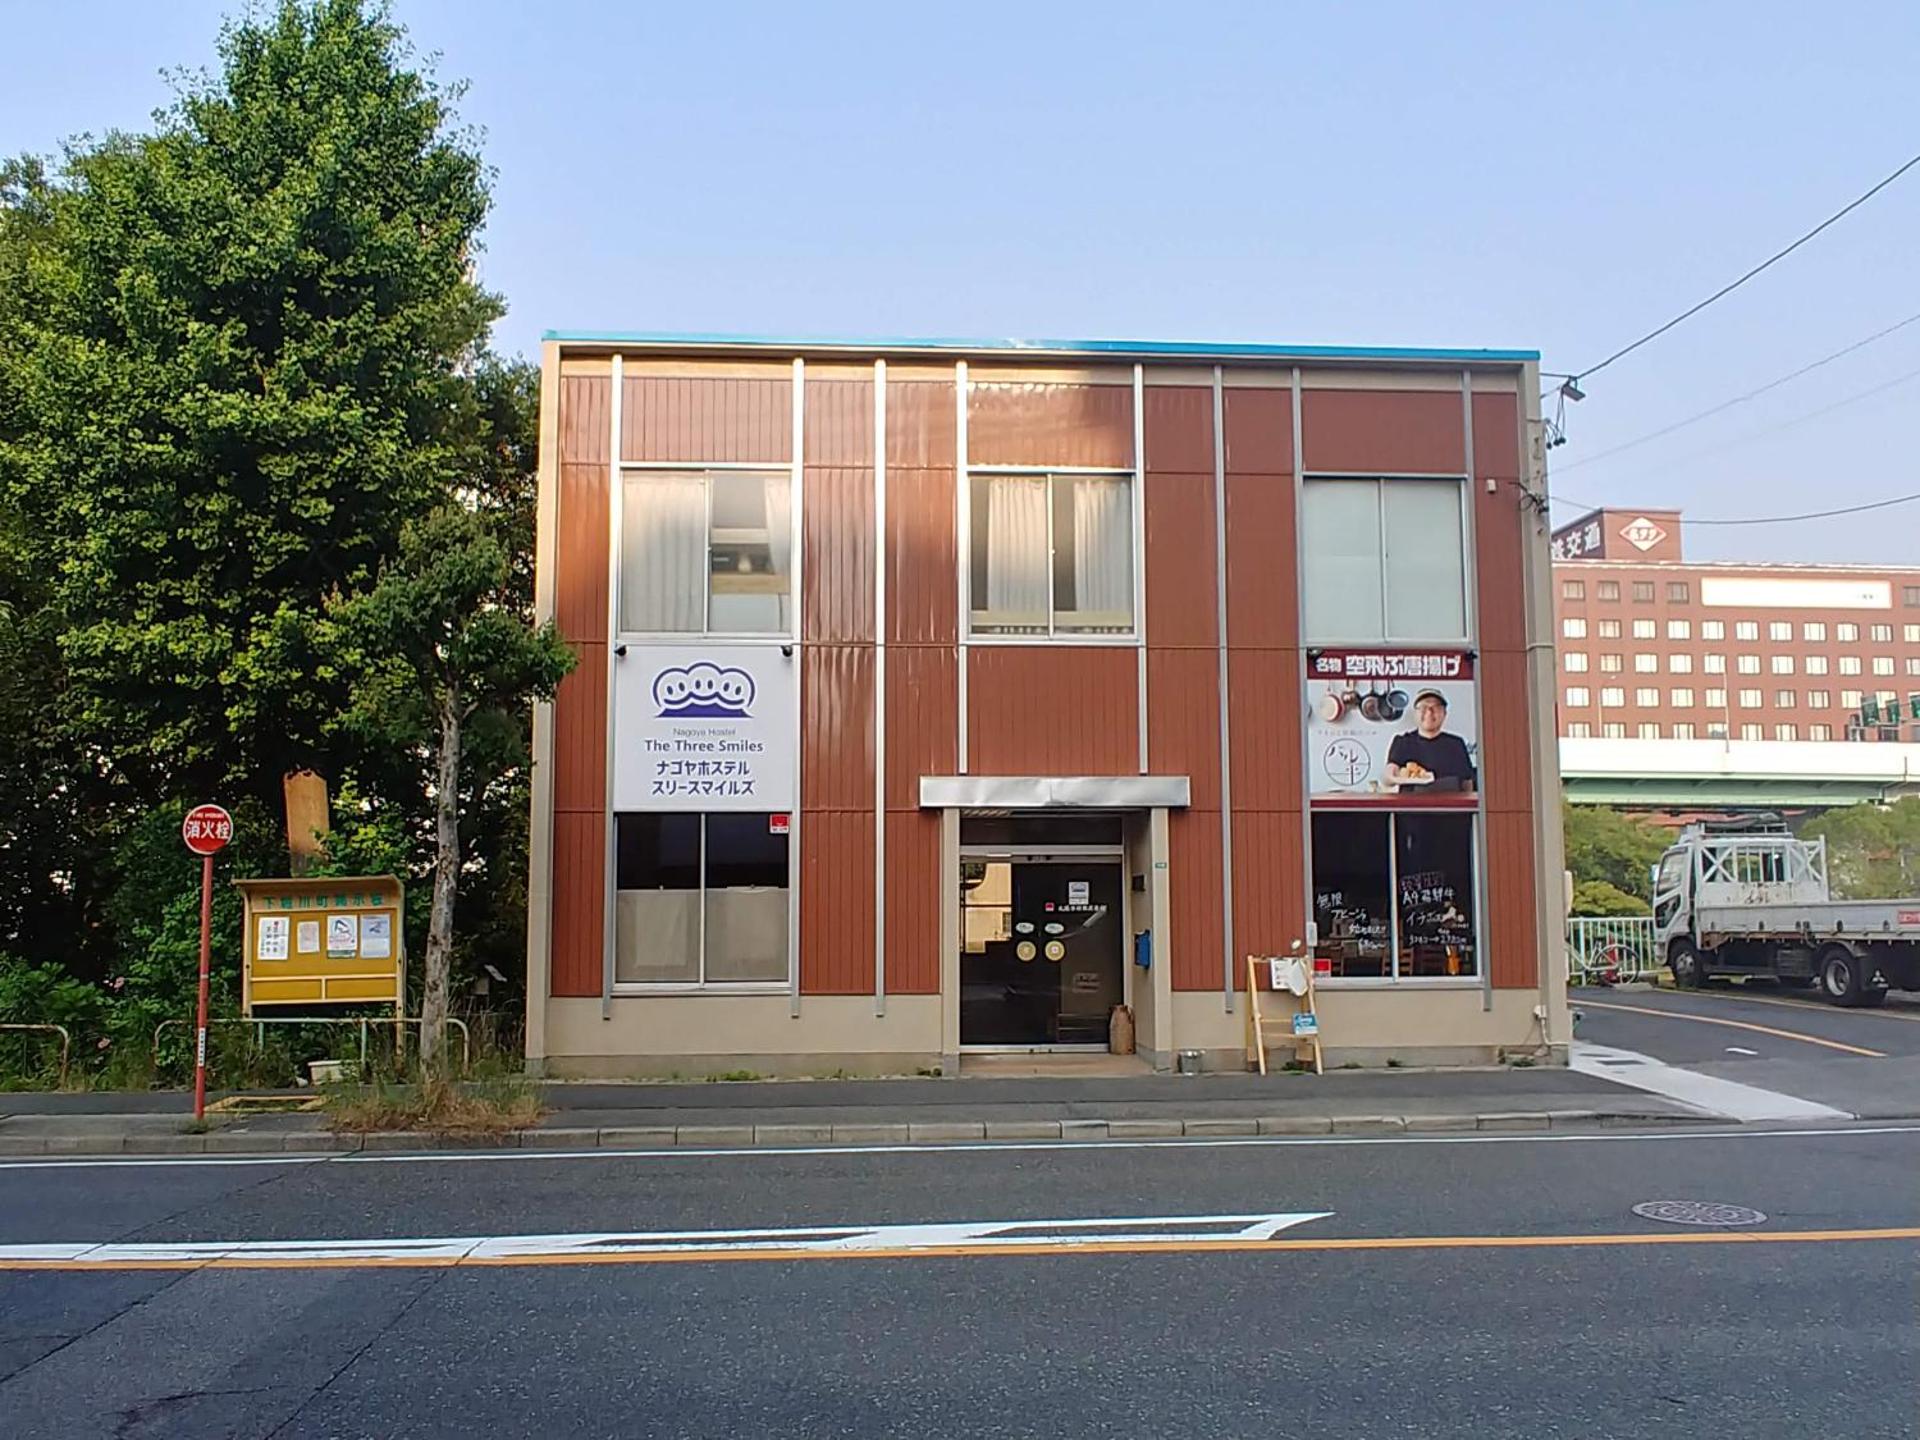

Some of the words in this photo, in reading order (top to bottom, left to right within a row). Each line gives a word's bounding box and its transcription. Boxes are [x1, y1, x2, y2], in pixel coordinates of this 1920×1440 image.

[1316, 658, 1342, 672] 名物
[1345, 655, 1461, 676] 空飛ぶ唐揚げ
[673, 728, 705, 737] Nagoya
[708, 728, 736, 736] Hostel
[645, 740, 671, 752] The
[675, 740, 715, 752] Three
[718, 740, 764, 752] Smiles
[656, 760, 750, 776] ナゴヤホステル
[652, 780, 756, 796] スリースマイルズ
[186, 820, 230, 839] 消火栓
